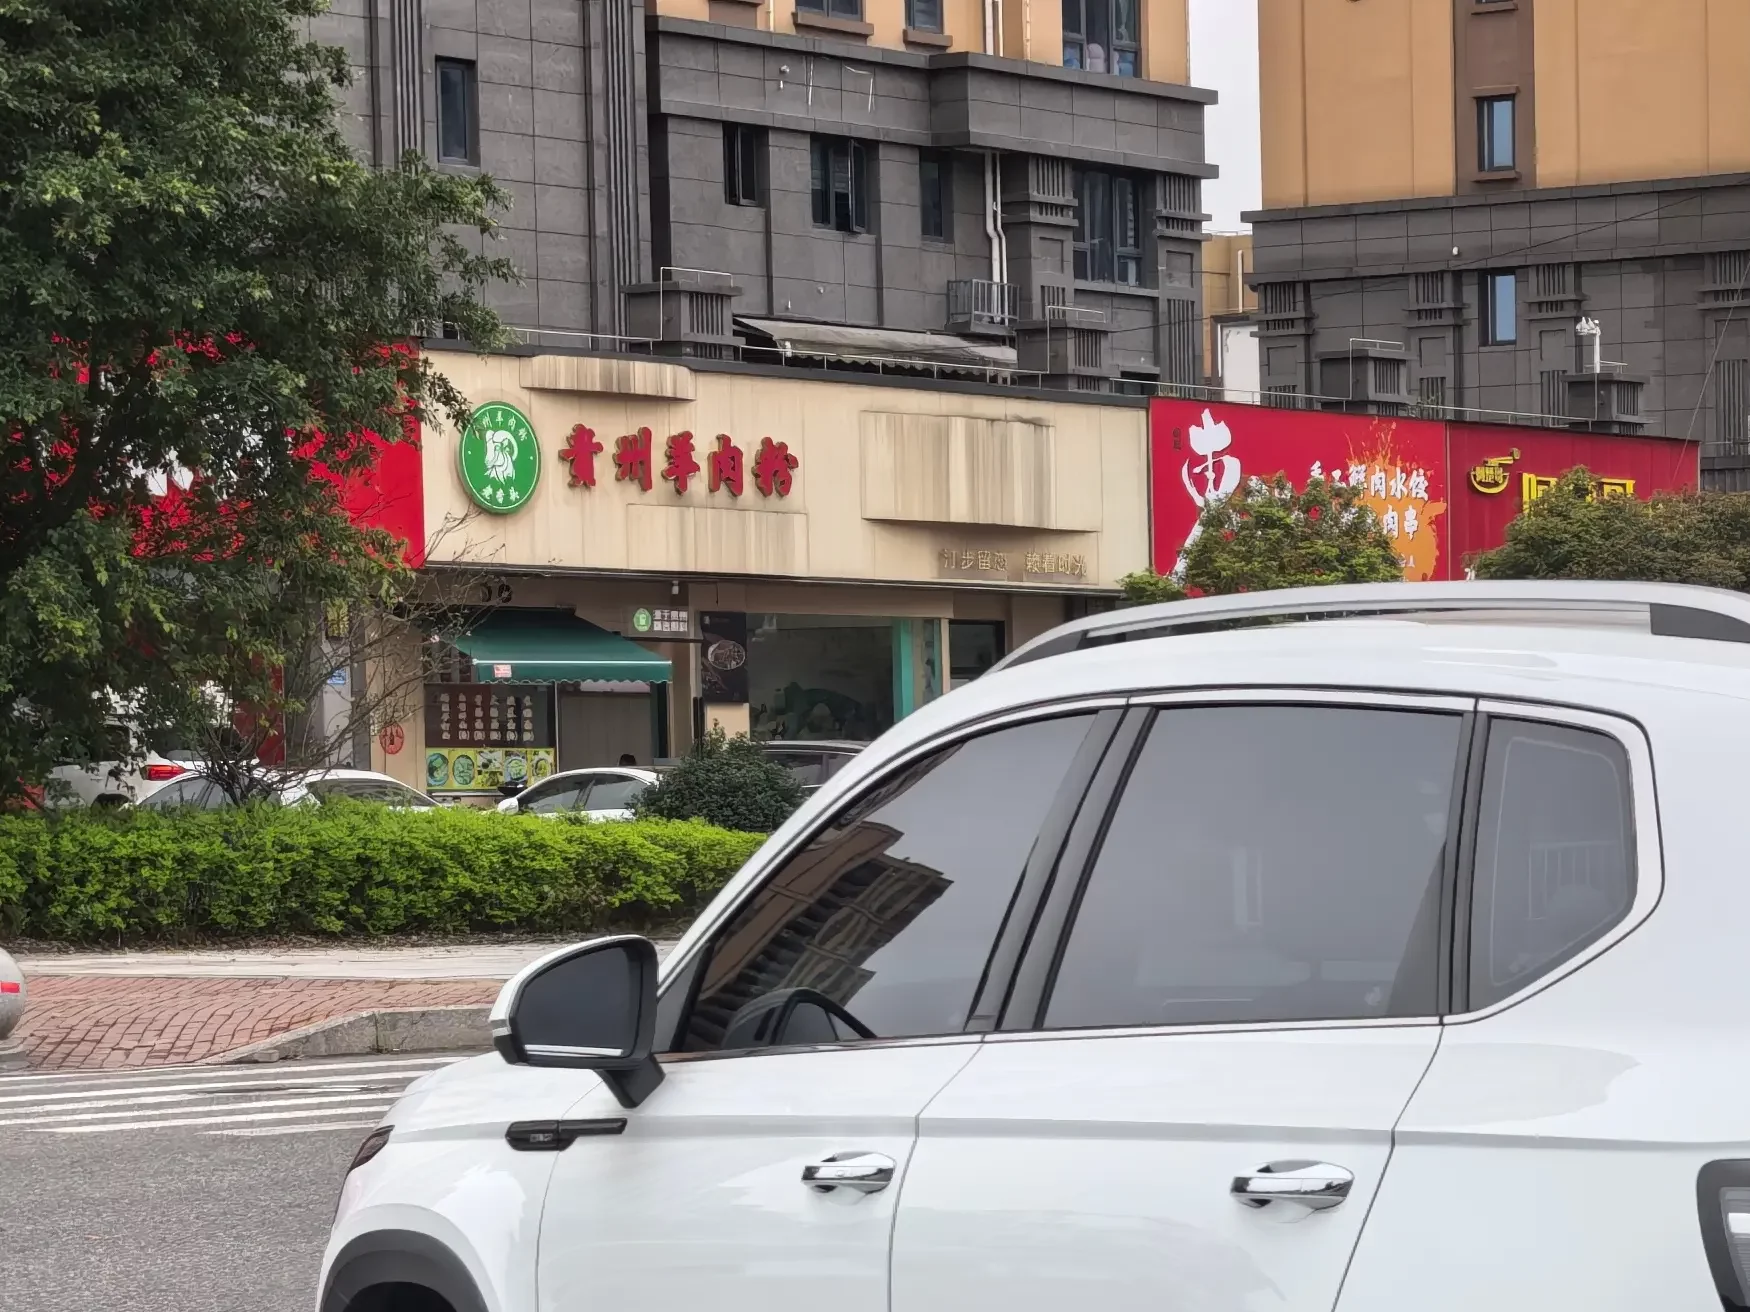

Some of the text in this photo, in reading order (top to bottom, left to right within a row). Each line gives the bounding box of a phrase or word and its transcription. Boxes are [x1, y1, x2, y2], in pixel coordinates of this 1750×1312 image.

[558, 423, 800, 498] 贵州羊肉粉
